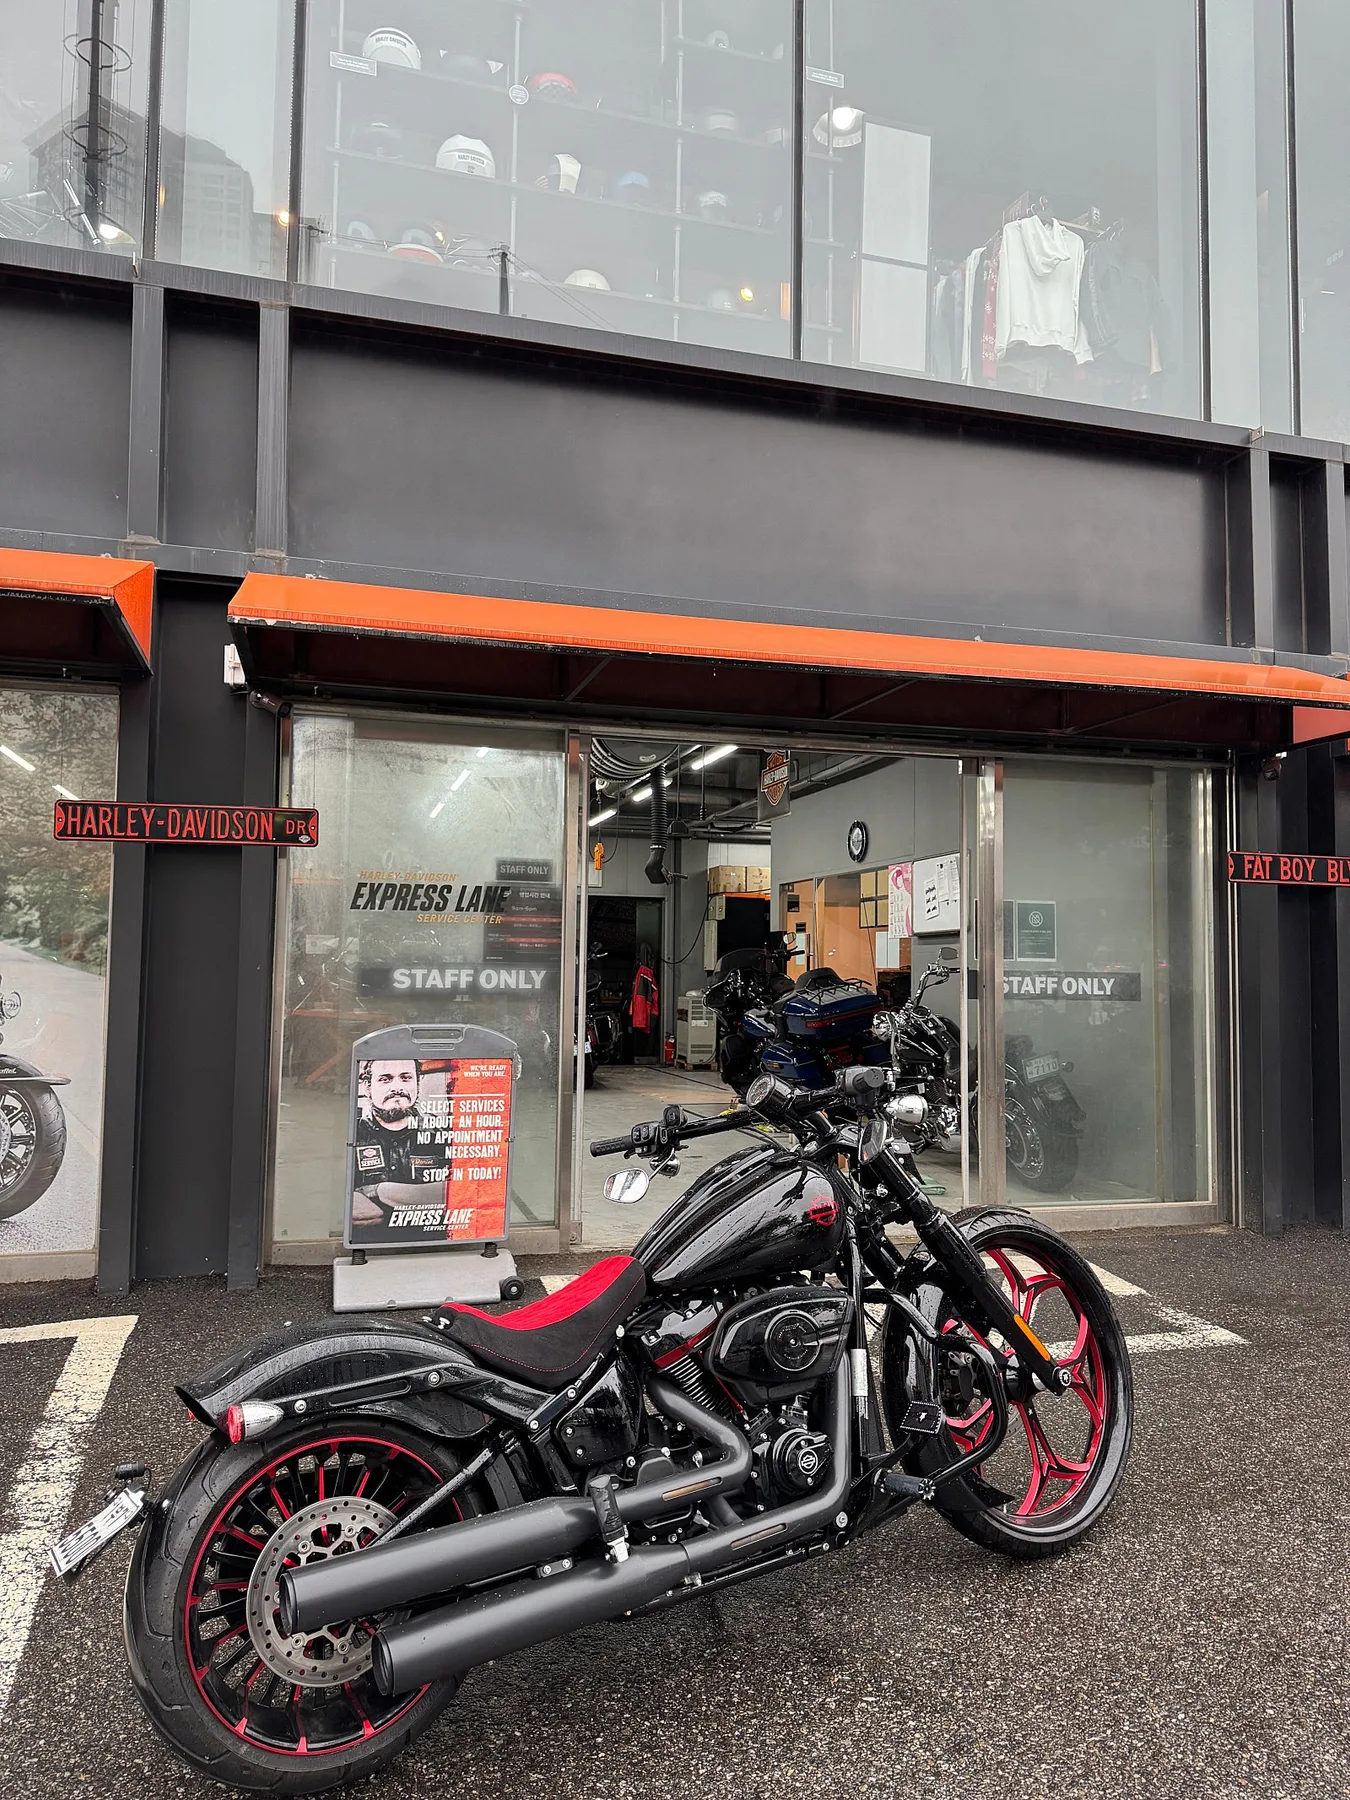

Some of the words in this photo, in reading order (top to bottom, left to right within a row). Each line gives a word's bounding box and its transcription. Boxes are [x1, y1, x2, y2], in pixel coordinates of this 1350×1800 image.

[67, 806, 273, 841] HARLEY-DAVIDSON
[285, 819, 306, 836] DR
[359, 870, 458, 882] HARLEY-DAVIDSON
[500, 864, 525, 874] STAFF
[527, 865, 549, 875] ONLY
[1243, 855, 1273, 879] FAT
[1280, 857, 1316, 881] BOY
[1327, 859, 1350, 883] BL
[349, 882, 453, 912] EXPRESS
[455, 885, 511, 913] LANE
[416, 913, 461, 924] SERVICE
[463, 914, 502, 925] CENTER
[392, 968, 474, 989] STAFF
[479, 969, 547, 989] ONLY
[1061, 977, 1116, 995] ONLY
[420, 1100, 455, 1113] SELECT
[459, 1100, 505, 1112] SERVICES
[408, 1117, 418, 1130] IN
[423, 1116, 455, 1129] ABOUT
[459, 1116, 472, 1128] AN
[476, 1116, 504, 1128] HOUR.
[417, 1132, 431, 1145] NO
[435, 1130, 503, 1144] APPOINTMENT
[445, 1145, 503, 1159] NECESSARY.
[360, 1158, 381, 1167] SERVICE
[422, 1168, 450, 1182] STOP
[453, 1168, 463, 1181] IN
[468, 1167, 502, 1180] TODAY!
[393, 1203, 446, 1211] HARLEY-DAVIDSON
[388, 1210, 443, 1227] EXPRESS
[443, 1208, 475, 1225] LANE
